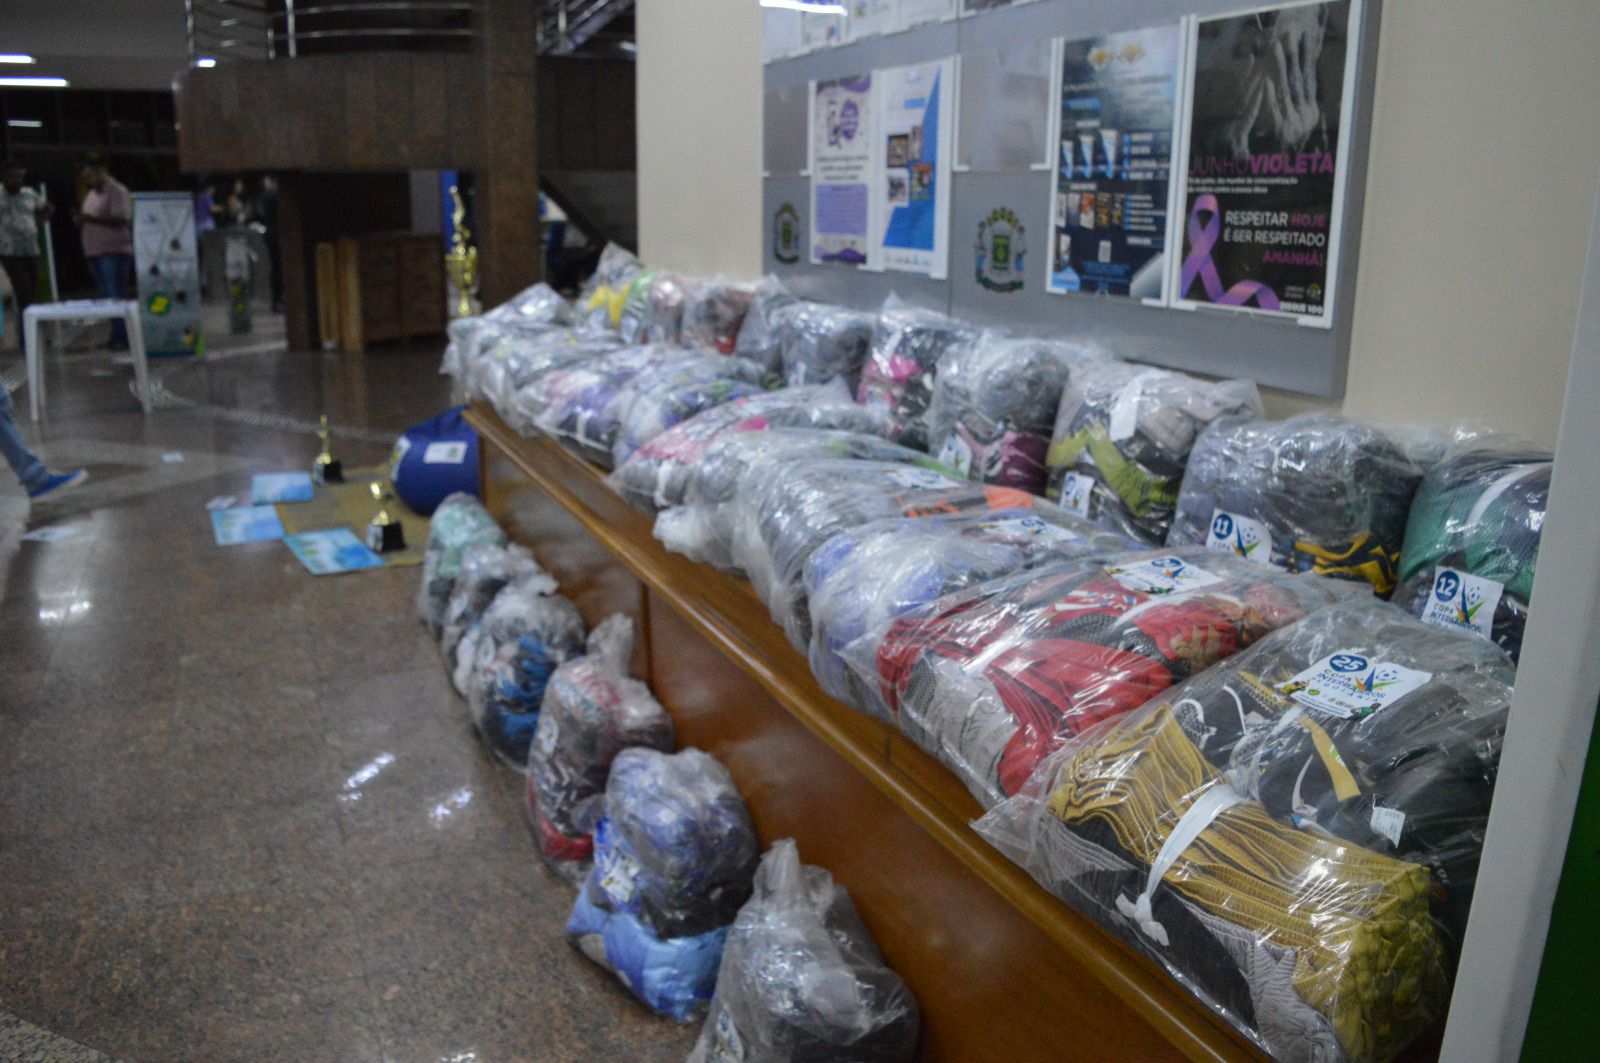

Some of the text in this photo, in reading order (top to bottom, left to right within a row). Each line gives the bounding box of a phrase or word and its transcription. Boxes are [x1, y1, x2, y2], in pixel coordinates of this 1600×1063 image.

[1189, 152, 1333, 175] JUNHO VIOLETA
[1225, 210, 1326, 228] RESPEITAR HOJE
[1224, 227, 1325, 247] É SER RESPEITADO
[1214, 518, 1230, 536] 11
[1437, 577, 1456, 596] 12
[1434, 603, 1454, 614] COPA
[1332, 656, 1363, 670] 25
[1324, 668, 1352, 682] COPA
